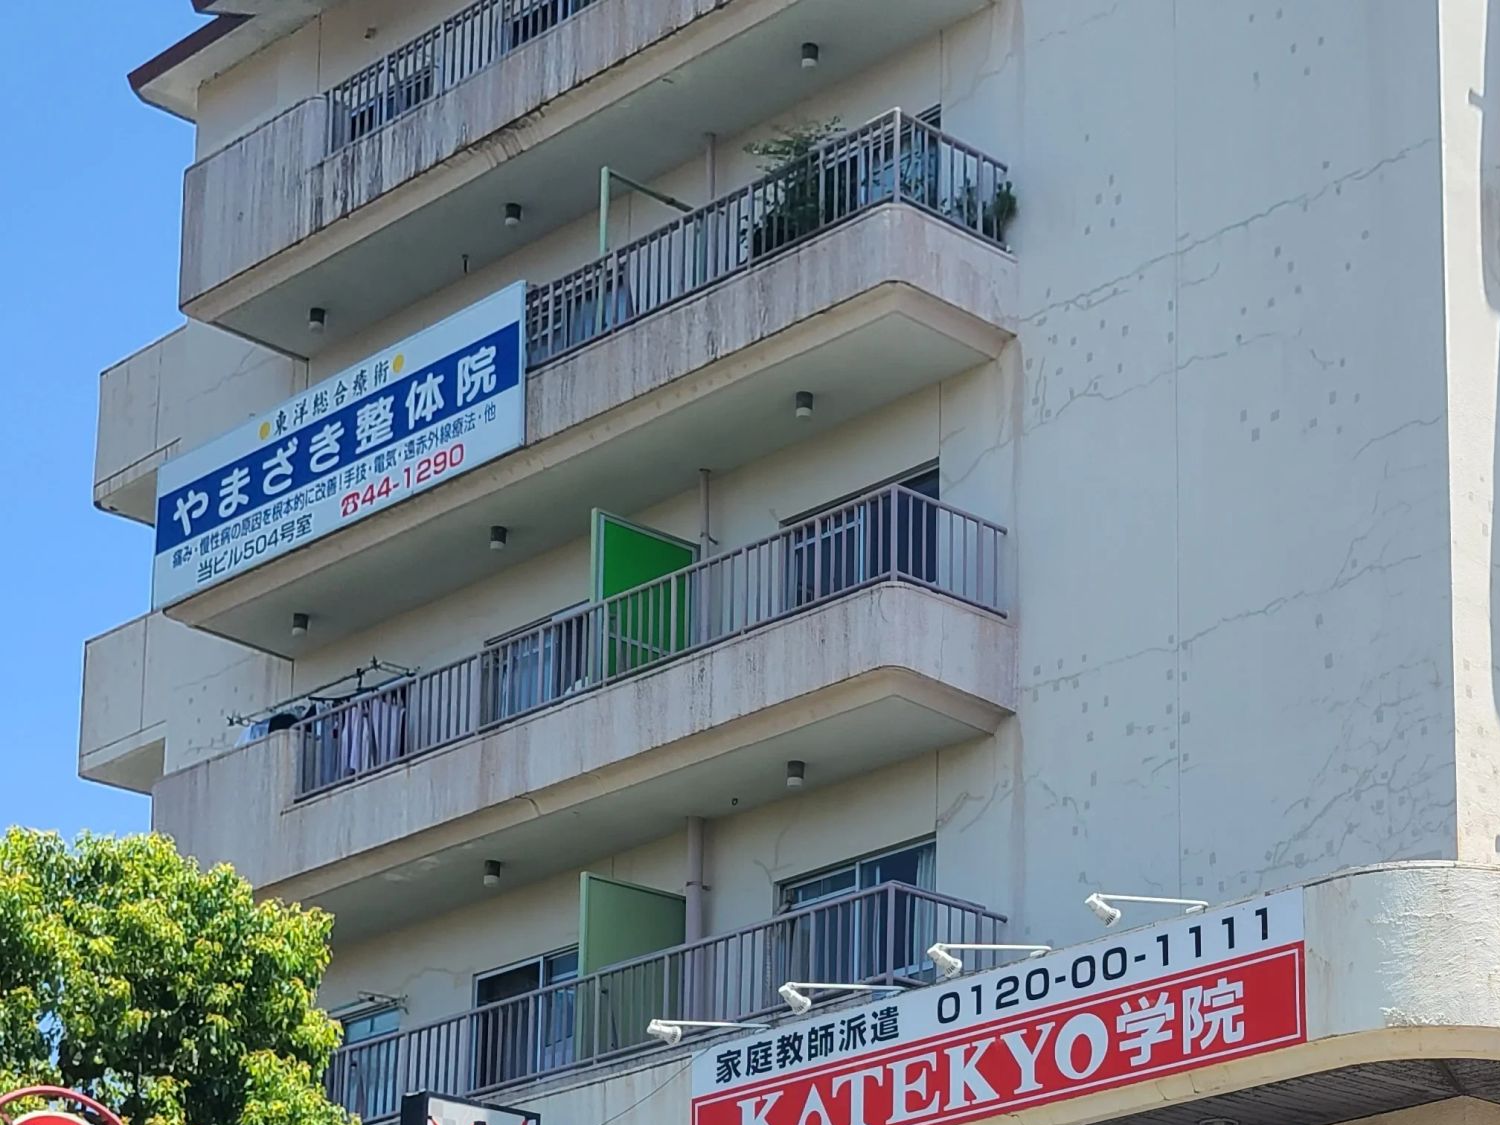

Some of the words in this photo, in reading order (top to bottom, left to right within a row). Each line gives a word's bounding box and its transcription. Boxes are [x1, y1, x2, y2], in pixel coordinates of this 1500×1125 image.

[274, 360, 390, 436] 東洋総合療術
[173, 345, 498, 537] やまざき整体院
[361, 443, 465, 507] 44-1290
[196, 513, 314, 584] 当ビル504号室
[937, 907, 1269, 1024] 0120-00-1111
[715, 1006, 900, 1084] 家庭教師派遣
